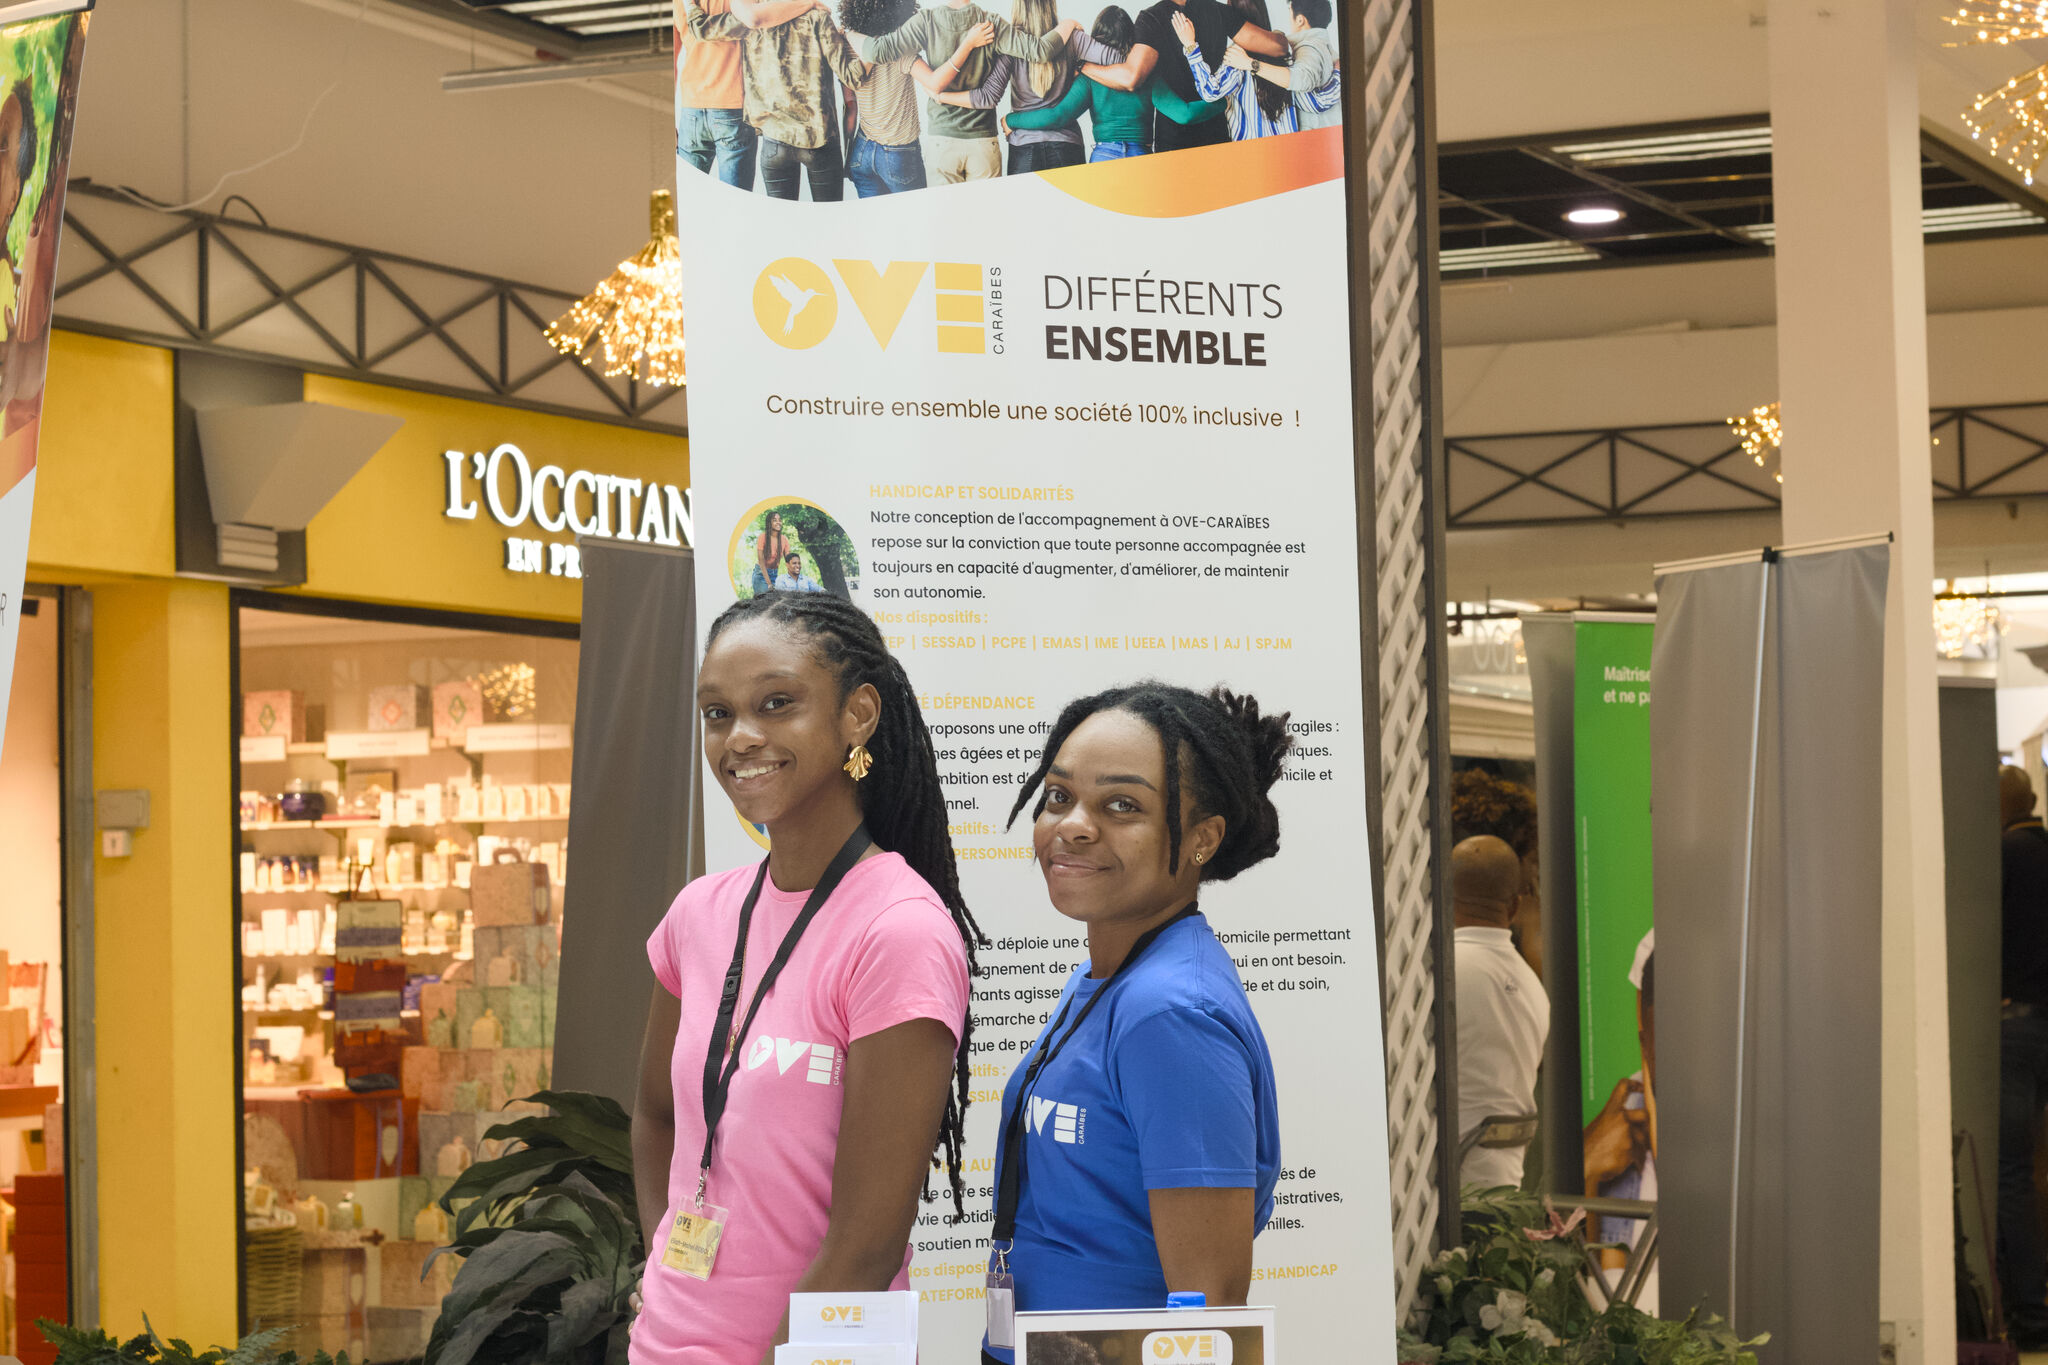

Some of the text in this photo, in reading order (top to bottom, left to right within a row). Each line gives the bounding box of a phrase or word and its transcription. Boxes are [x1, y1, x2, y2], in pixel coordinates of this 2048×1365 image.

[1045, 269, 1283, 319] DIFFÉRENTS
[752, 256, 986, 354] OVE
[989, 266, 1005, 355] CARAÏBES
[1045, 325, 1267, 366] ENSEMBLE
[766, 394, 884, 417] Construire
[891, 399, 1000, 419] ensemble
[1007, 404, 1047, 421] une
[1054, 402, 1132, 423] société
[1138, 404, 1187, 425] 100%
[1193, 405, 1283, 428] inclusive
[445, 443, 695, 549] L'OCCITAN
[869, 484, 1074, 502] HANDICAP ET SOLIDARITÉS
[870, 511, 1270, 530] Notre conception de l'accompagnement à OVE-CARAÏBES
[871, 536, 1306, 557] repose sur la conviction que toute personne accompagnée est
[507, 537, 582, 578] EN PR
[872, 561, 1290, 579] toujours en capacité d'augmenter, d'améliorer, de maintenir
[873, 586, 986, 599] son autonomie.
[874, 611, 903, 624] Nos
[906, 611, 981, 627] dispositifs
[922, 636, 976, 649] SESSAD
[992, 637, 1027, 649] PCPE
[1043, 637, 1082, 649] EMAS
[1095, 637, 1119, 649] IME
[1132, 637, 1166, 649] UEEA
[1179, 638, 1208, 649] MAS
[1224, 638, 1241, 650] AJ
[1256, 638, 1292, 650] SPJM
[1604, 665, 1651, 682] Maîtrise
[934, 692, 1036, 710] DÉPENDANCE
[1604, 690, 1616, 703] et
[1620, 691, 1636, 703] ne
[929, 721, 1051, 738] roposons une offr
[1286, 720, 1332, 736] ragiles
[960, 746, 1003, 763] âgées
[1006, 748, 1020, 759] et
[939, 771, 988, 784] mbition
[992, 772, 1013, 784] est
[1319, 769, 1333, 780] et
[947, 821, 990, 834] ositifs
[997, 937, 1049, 953] déploie
[1053, 938, 1079, 948] une
[1273, 928, 1351, 946] permettant
[1251, 957, 1268, 967] en
[1271, 955, 1293, 967] ont
[1297, 952, 1346, 966] besoin.
[981, 963, 1046, 980] gnement
[1049, 961, 1067, 974] de
[1261, 980, 1275, 991] et
[1278, 979, 1295, 990] du
[1299, 977, 1330, 991] soin,
[971, 987, 1063, 1003] nants agisse
[973, 1013, 1035, 1026] émarche
[999, 1039, 1016, 1051] de
[748, 1035, 835, 1085] OVE
[1299, 1167, 1316, 1179] de
[917, 1213, 939, 1226] vie
[918, 1236, 974, 1251] soutien
[934, 1259, 989, 1279] disposi
[1267, 1263, 1338, 1280] HANDICAP
[919, 1288, 987, 1303] ATEFORM
[821, 1306, 862, 1322] OVE
[1153, 1335, 1213, 1359] OVE
